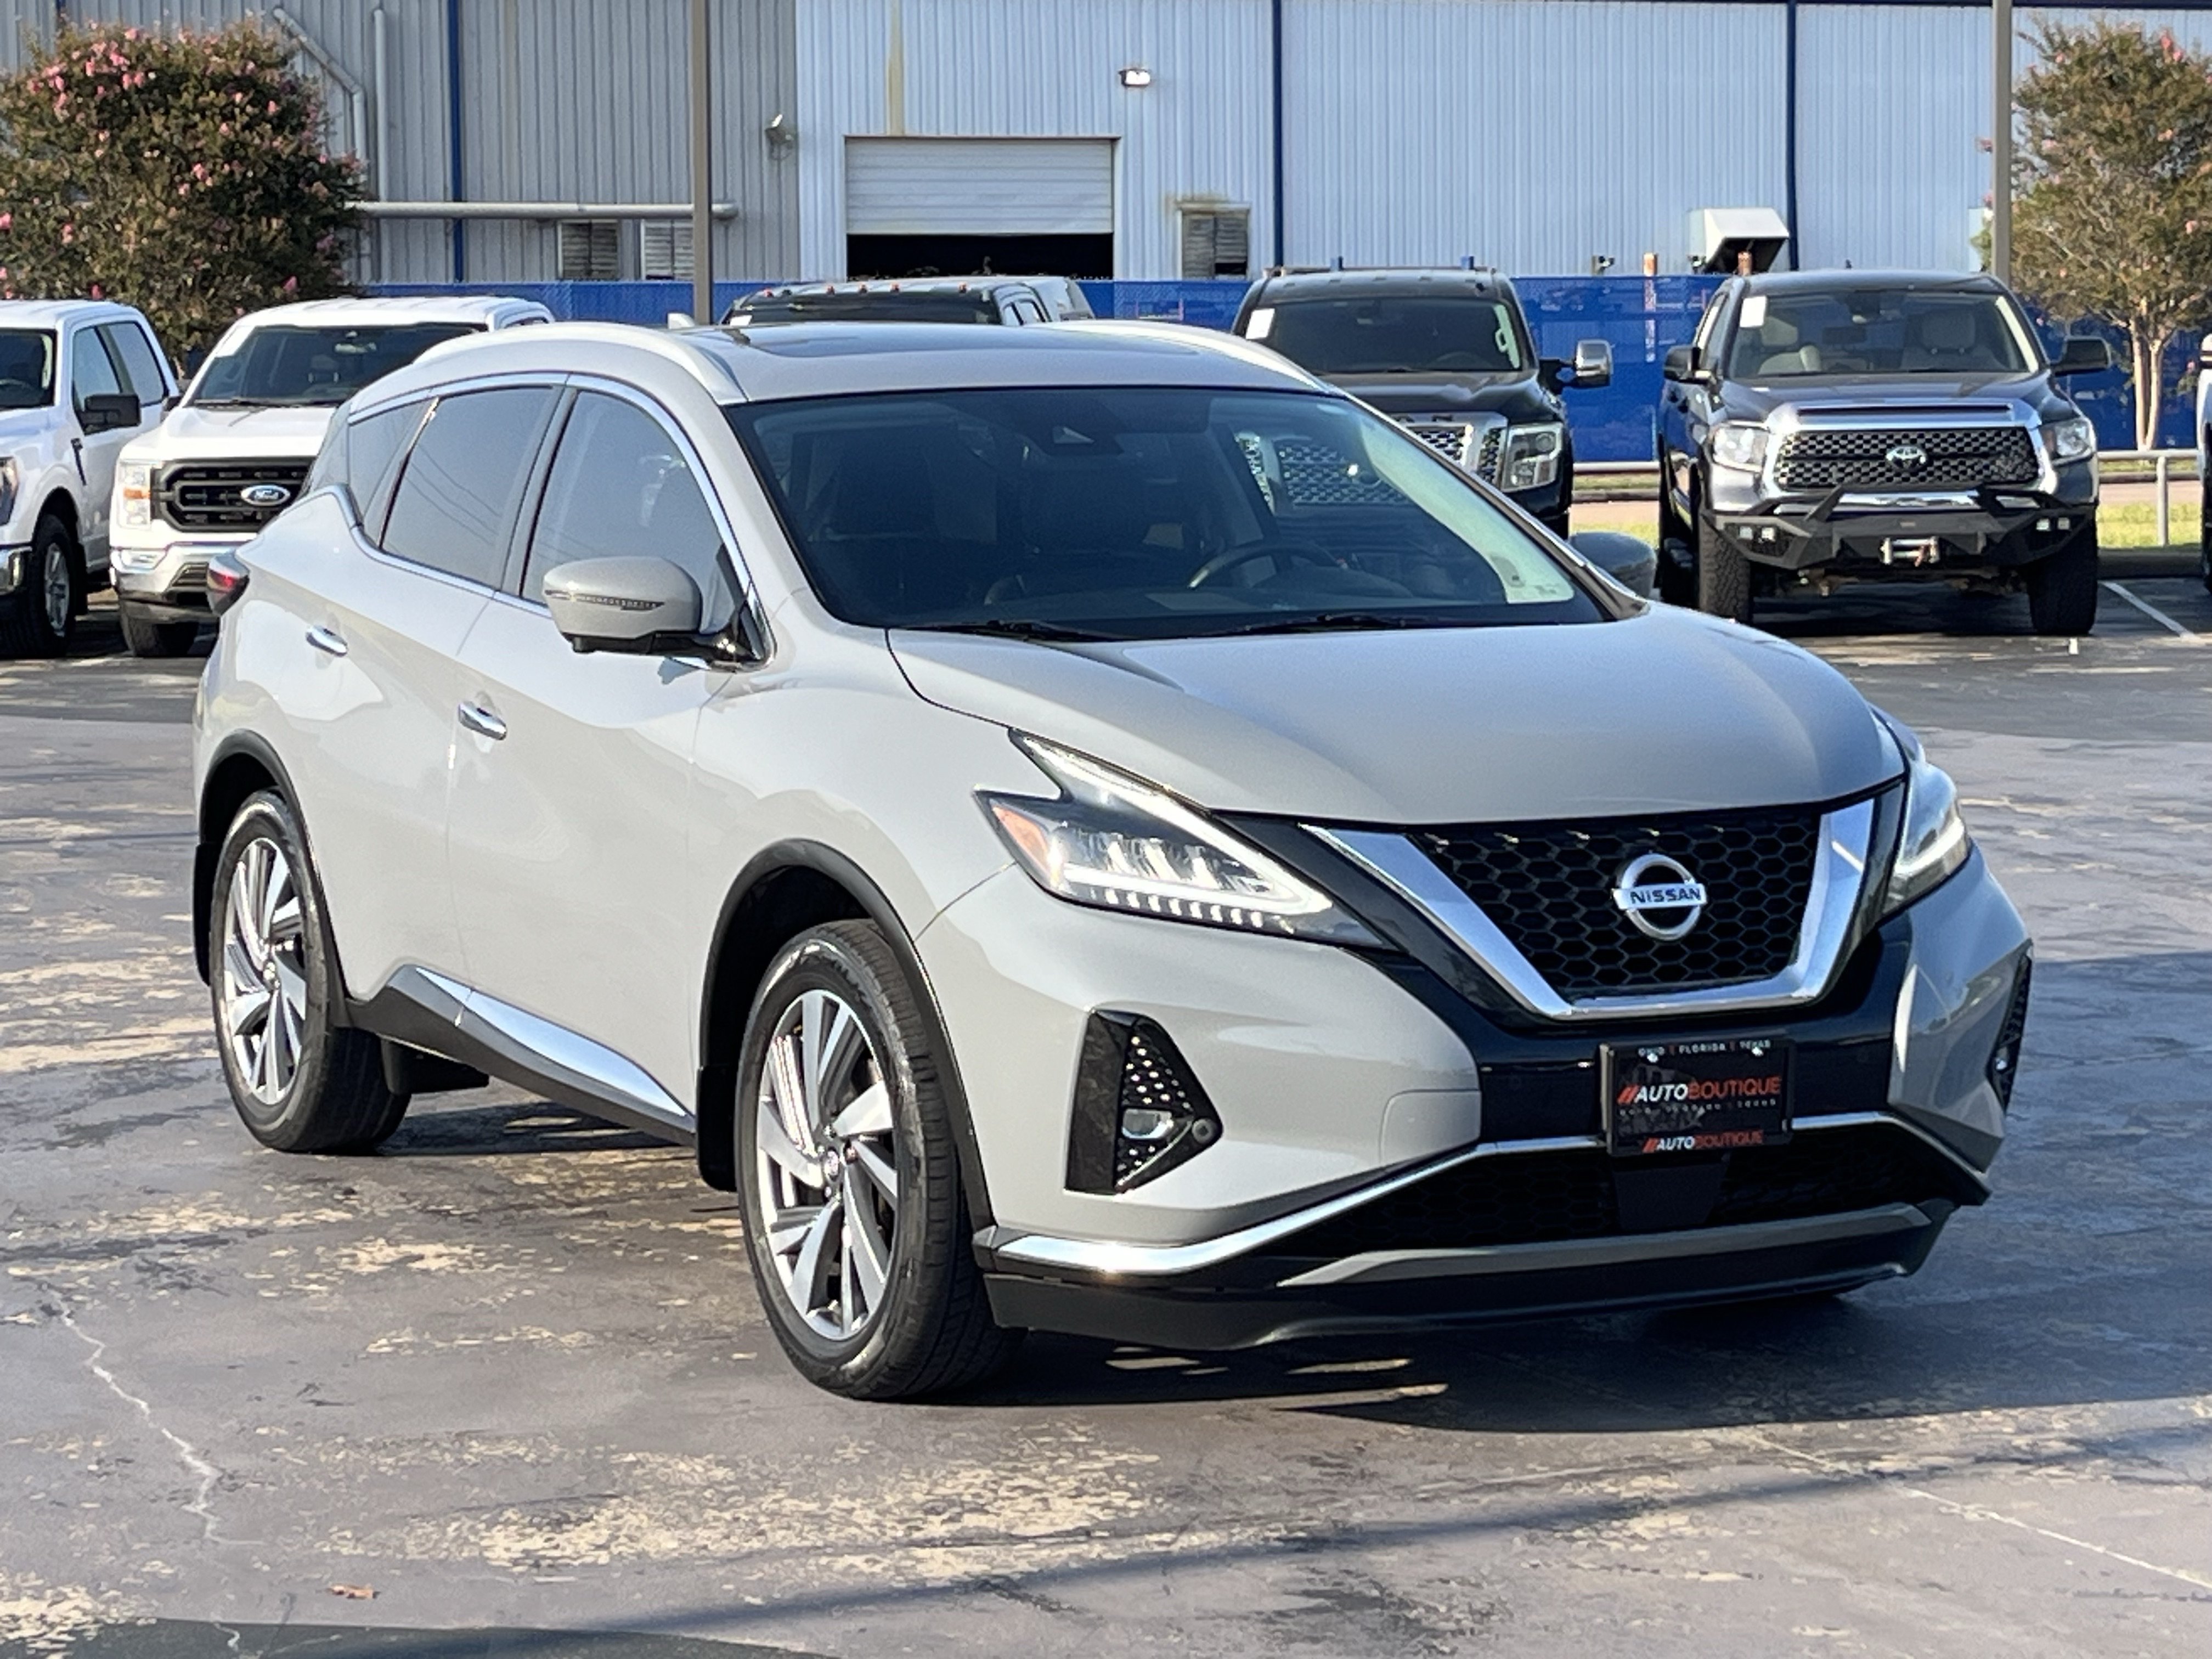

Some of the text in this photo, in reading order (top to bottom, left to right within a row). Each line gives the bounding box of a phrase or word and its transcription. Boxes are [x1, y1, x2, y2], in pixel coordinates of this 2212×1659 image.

[1630, 888, 1701, 904] NISSAN
[1679, 1042, 1725, 1054] FLORIDA
[1634, 1076, 1781, 1103] AUTOBOUTIQUE
[1656, 1130, 1763, 1151] AUTOBOUTIQUE
